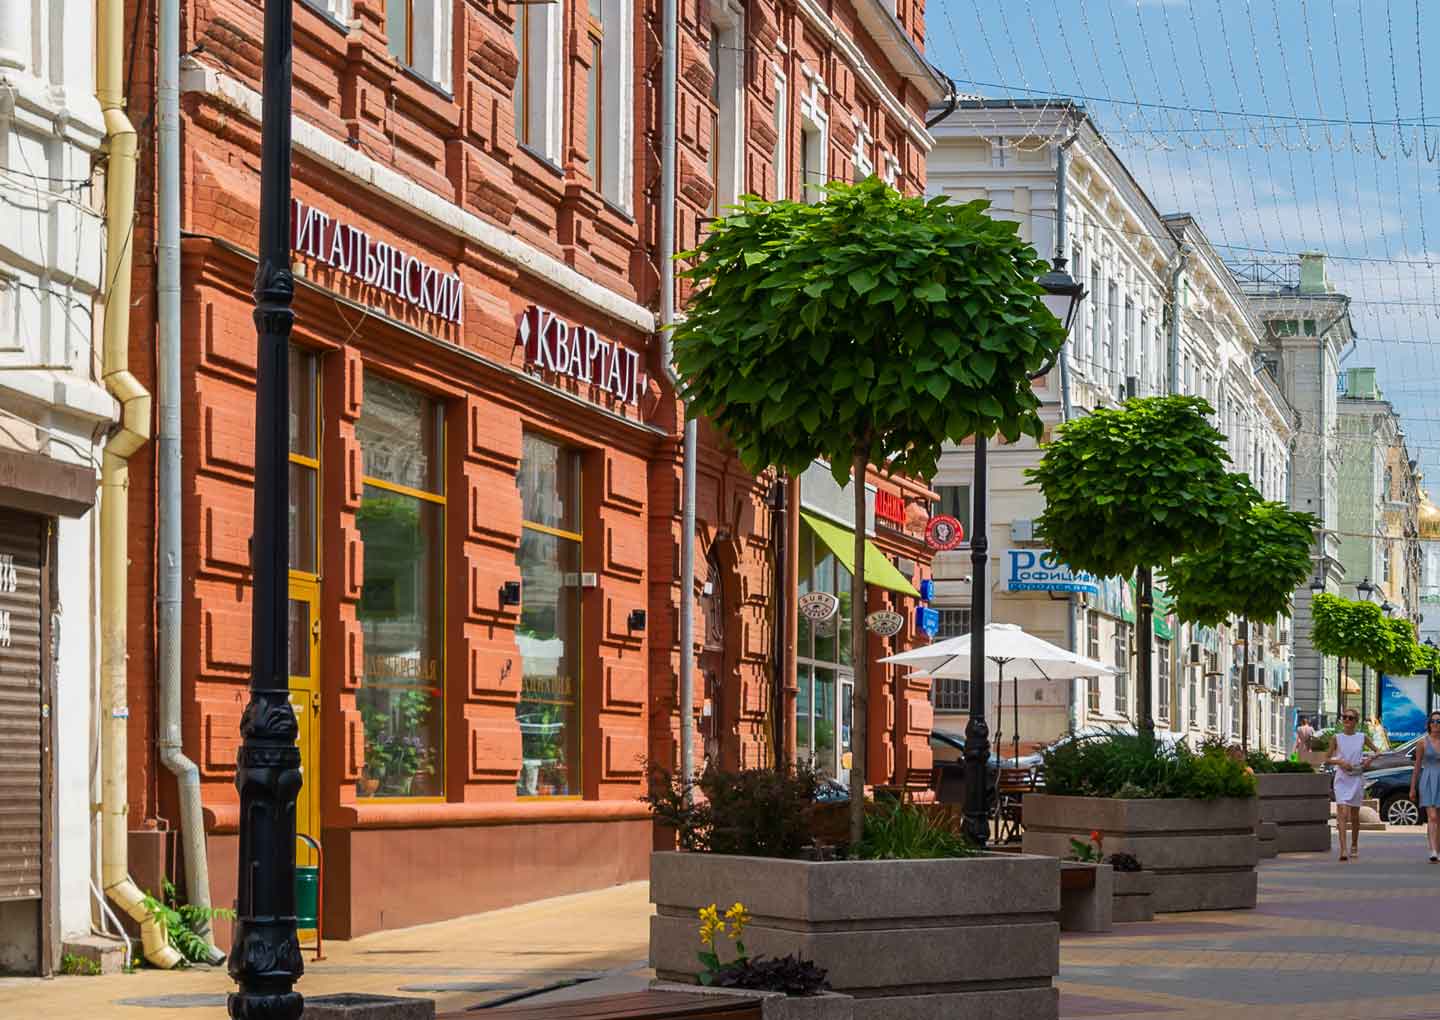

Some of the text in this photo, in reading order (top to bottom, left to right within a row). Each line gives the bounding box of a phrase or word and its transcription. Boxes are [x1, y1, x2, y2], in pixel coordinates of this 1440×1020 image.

[295, 199, 464, 325] ИТАЛЬЯНСКИЙ
[534, 304, 640, 406] КВАРТАЛ
[801, 594, 830, 604] SURF
